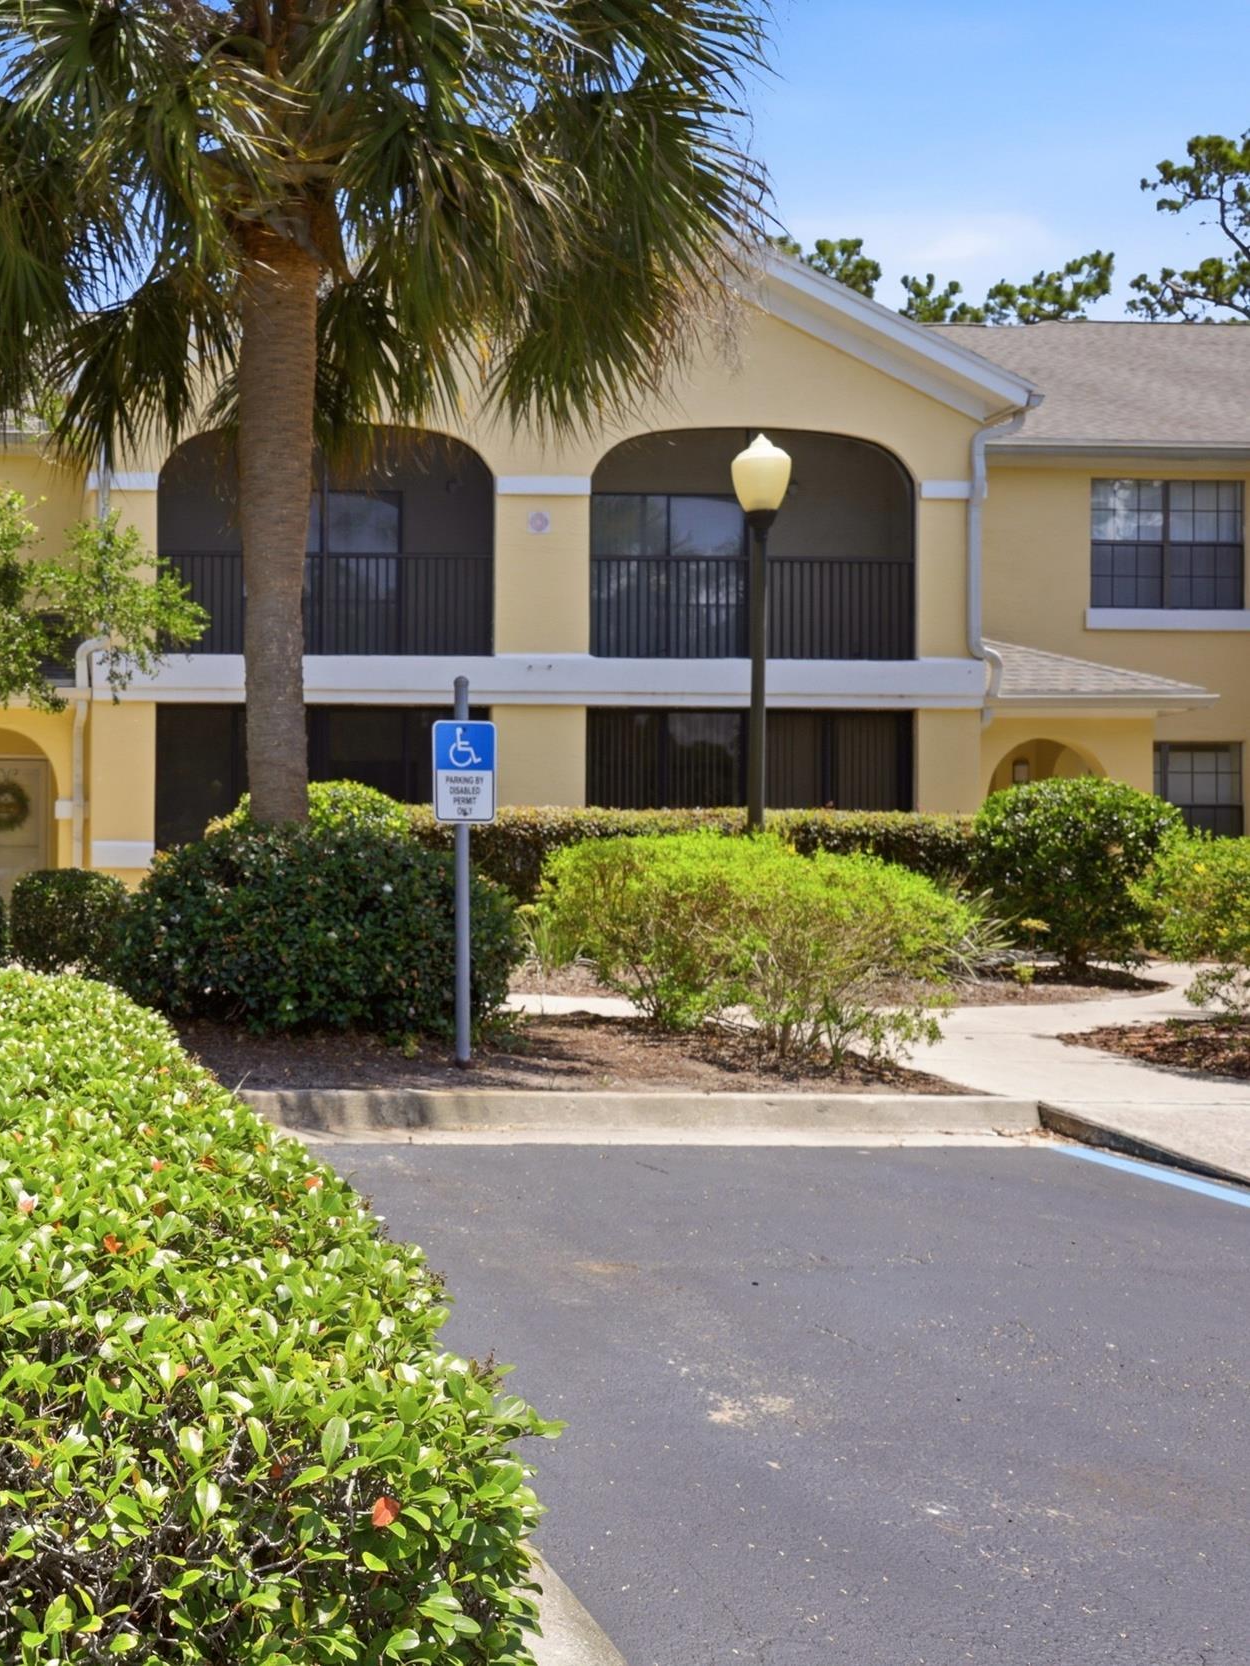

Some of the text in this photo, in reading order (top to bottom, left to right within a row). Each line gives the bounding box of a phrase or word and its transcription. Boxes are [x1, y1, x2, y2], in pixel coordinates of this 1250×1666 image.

[446, 776, 484, 784] PARKING BY
[450, 786, 481, 795] DISABLED
[453, 796, 477, 805] PERMIT
